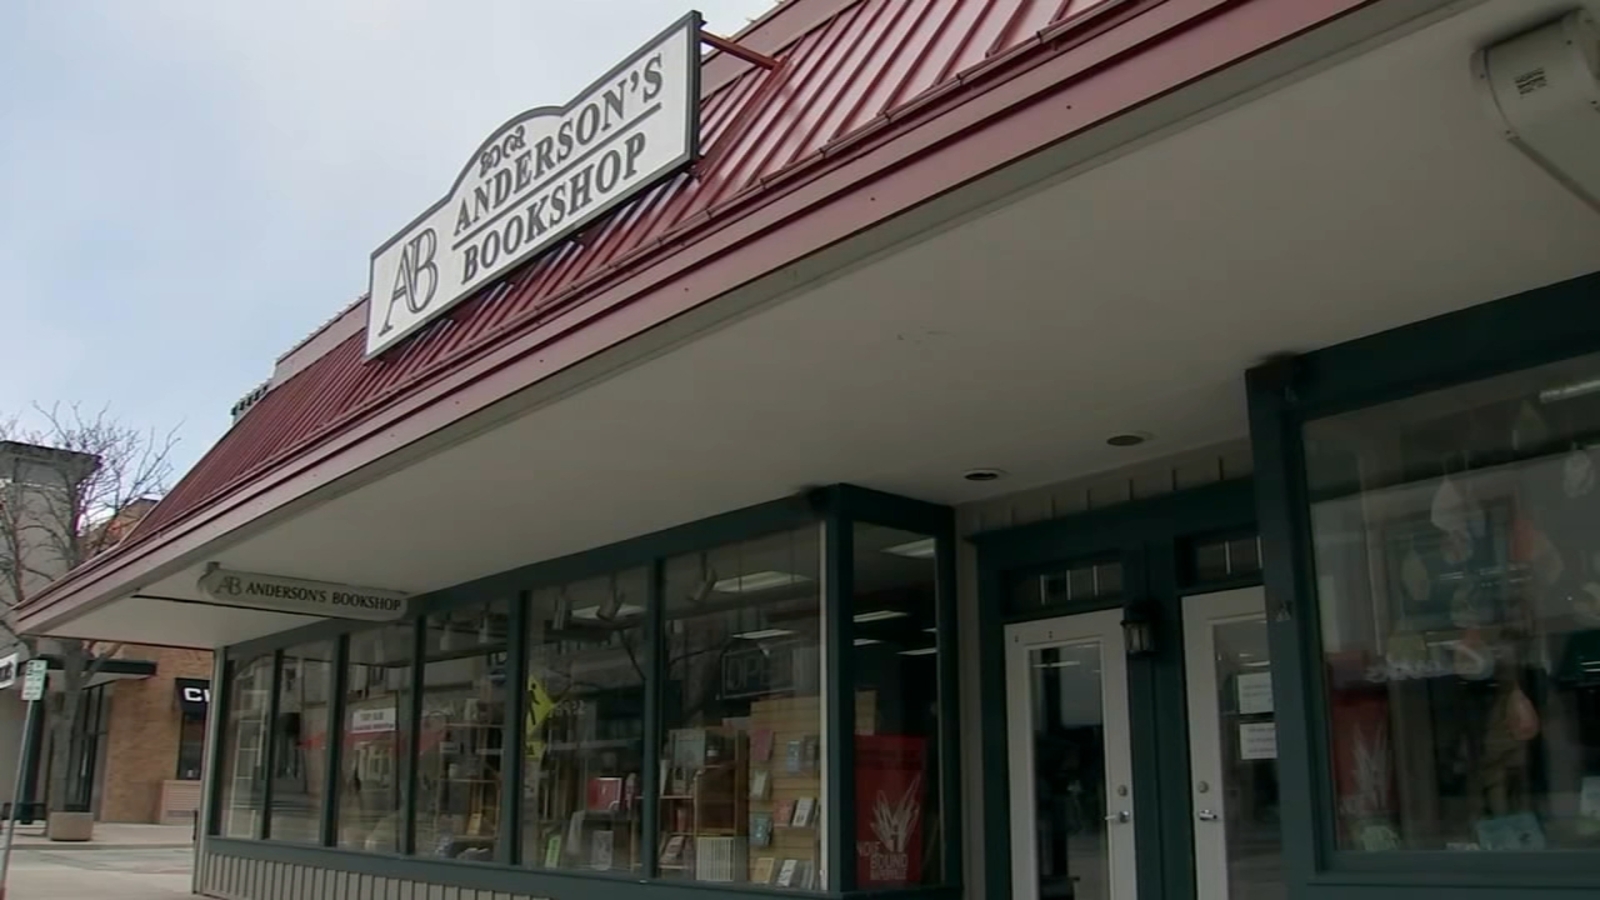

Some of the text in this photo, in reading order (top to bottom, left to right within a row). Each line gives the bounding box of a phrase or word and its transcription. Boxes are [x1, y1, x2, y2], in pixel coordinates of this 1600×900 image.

[453, 53, 663, 237] ANDERSON'S
[461, 131, 646, 286] BOOKSHOP
[378, 227, 439, 337] AB
[245, 582, 327, 604] ANDERSON'S
[332, 592, 402, 611] BOOKSHOP
